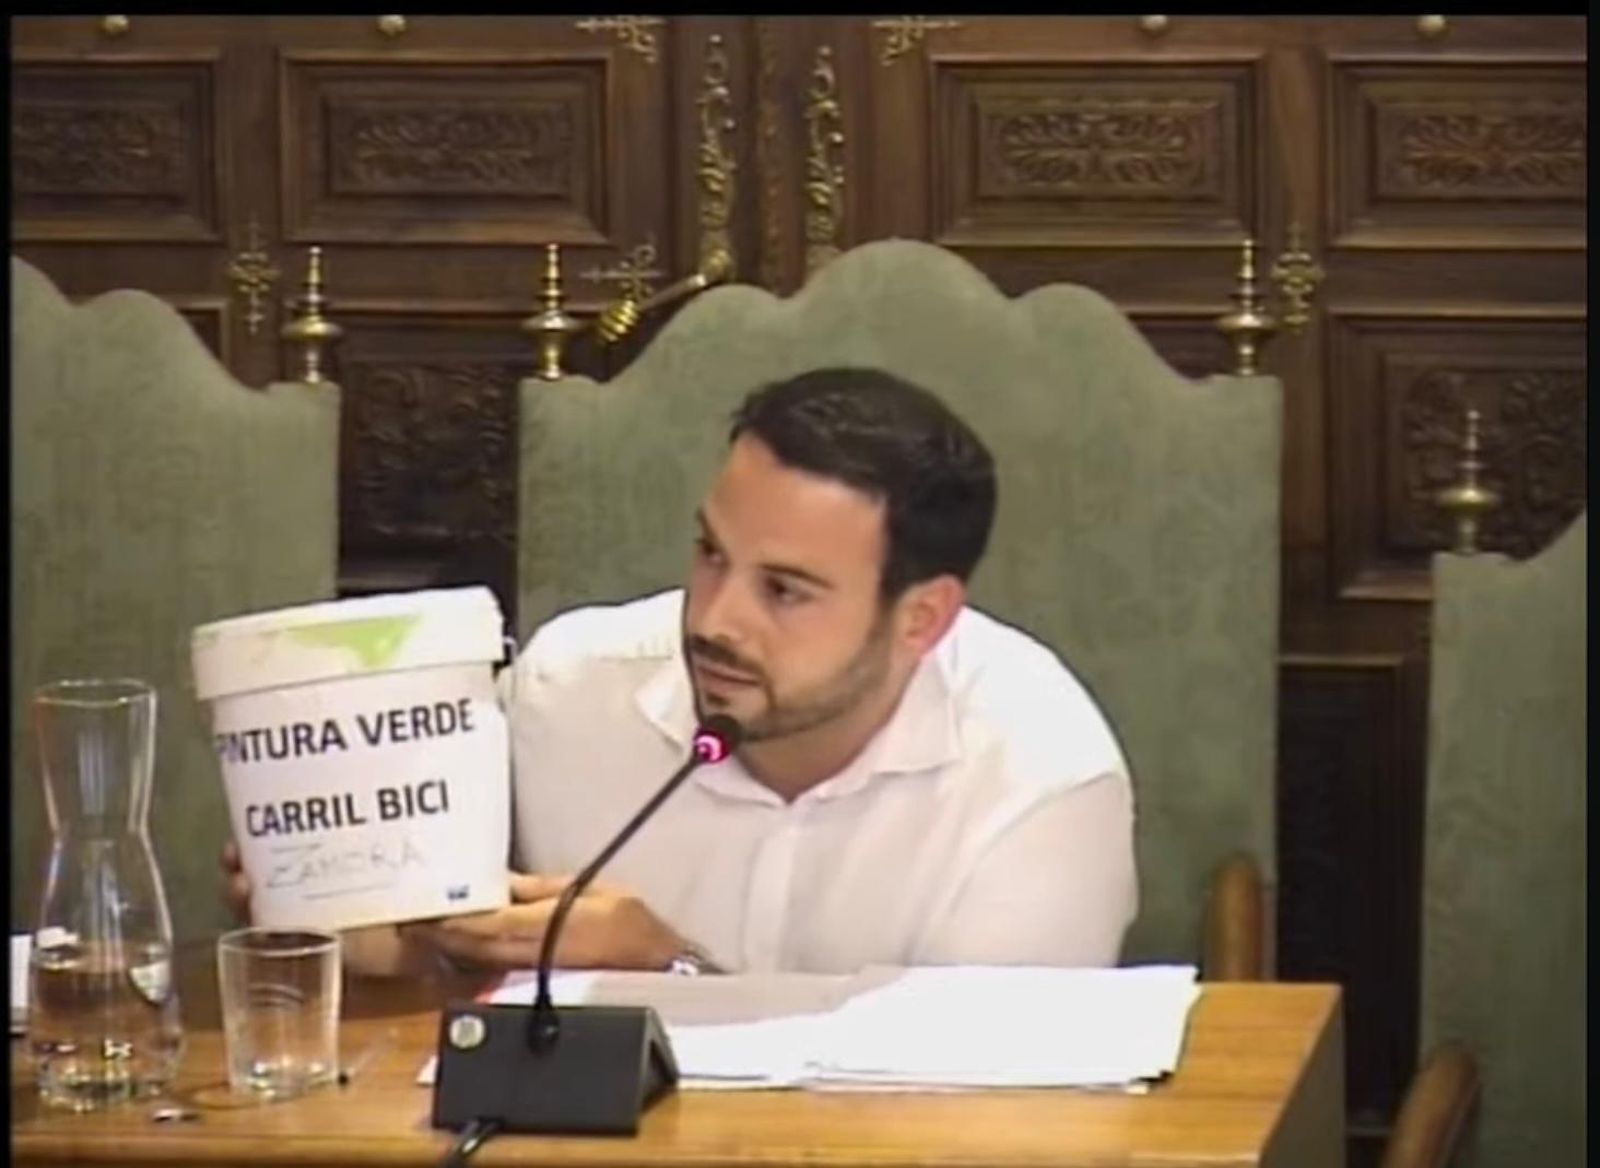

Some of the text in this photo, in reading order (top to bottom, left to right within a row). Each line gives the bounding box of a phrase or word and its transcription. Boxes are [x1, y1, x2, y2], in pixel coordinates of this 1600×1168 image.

[356, 698, 474, 746] VERDE
[245, 779, 449, 838] CARRIL BICI
